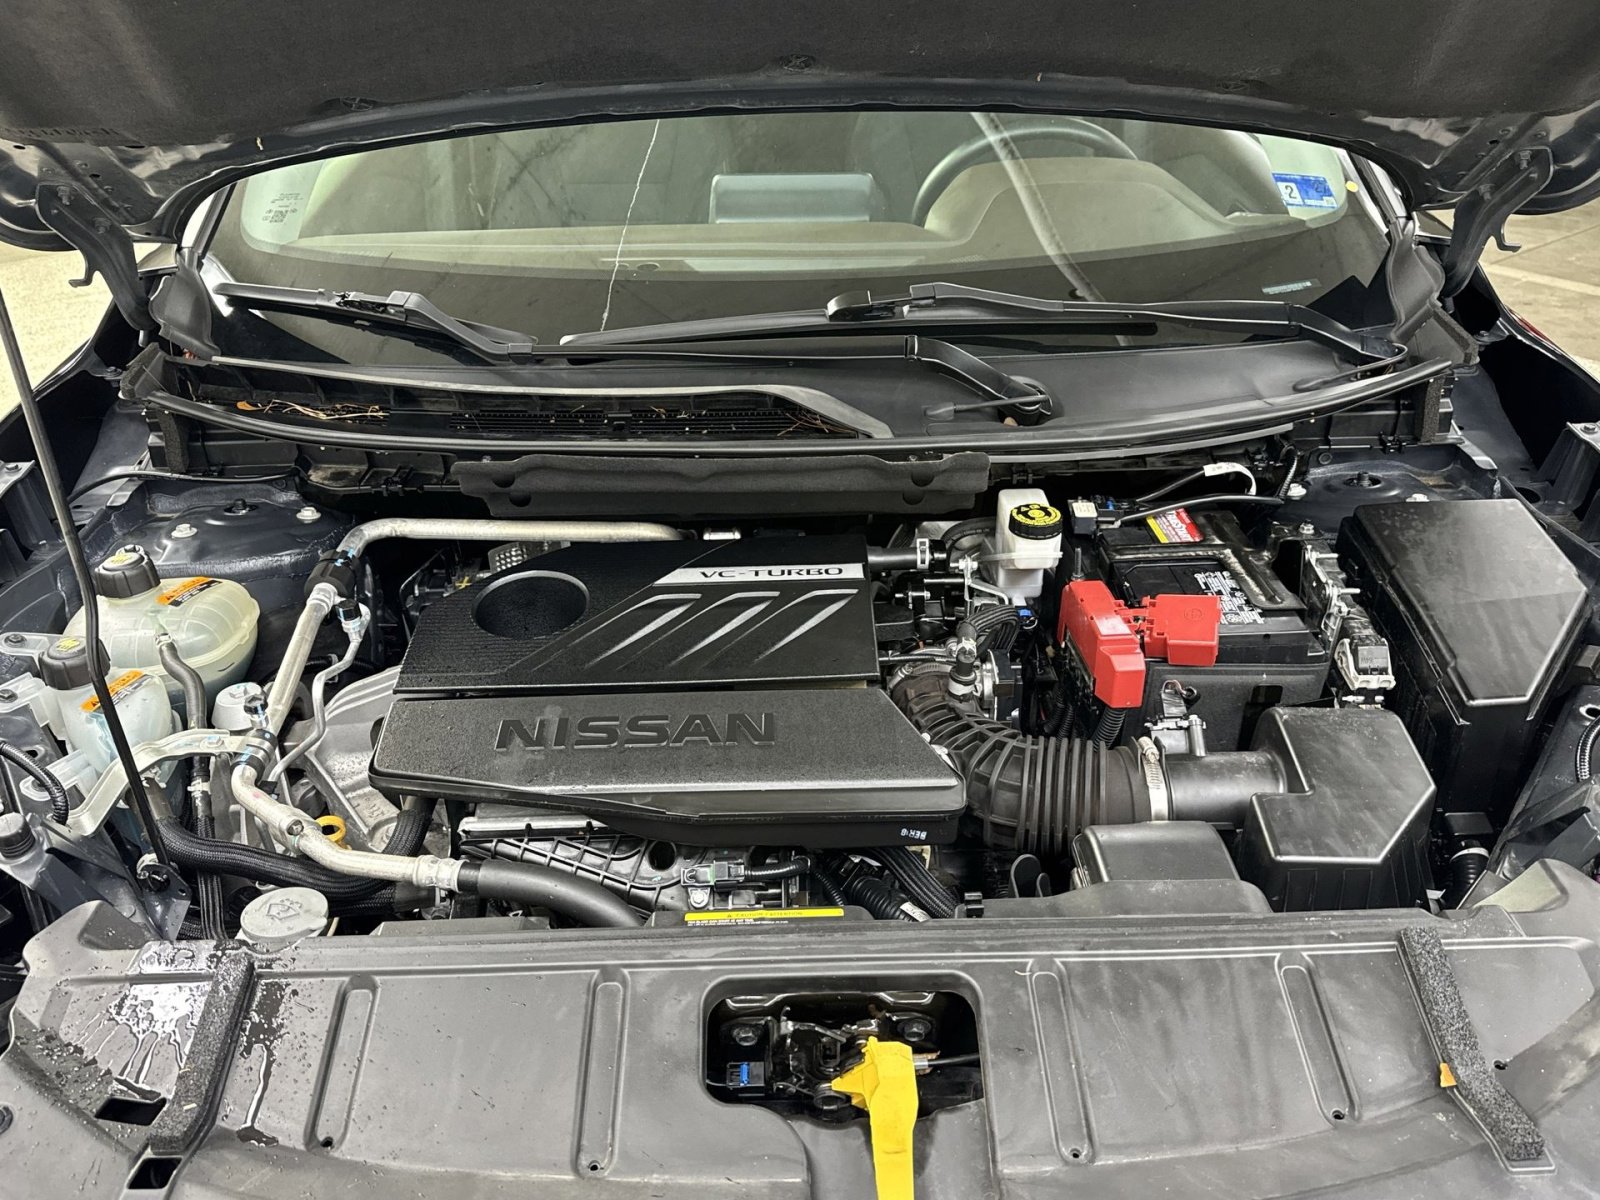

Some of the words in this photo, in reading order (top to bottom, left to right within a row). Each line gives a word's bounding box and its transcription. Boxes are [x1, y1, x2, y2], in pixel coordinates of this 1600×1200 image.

[1284, 185, 1297, 199] 2
[699, 567, 844, 578] VC-TURBO
[494, 712, 776, 751] NISSAN
